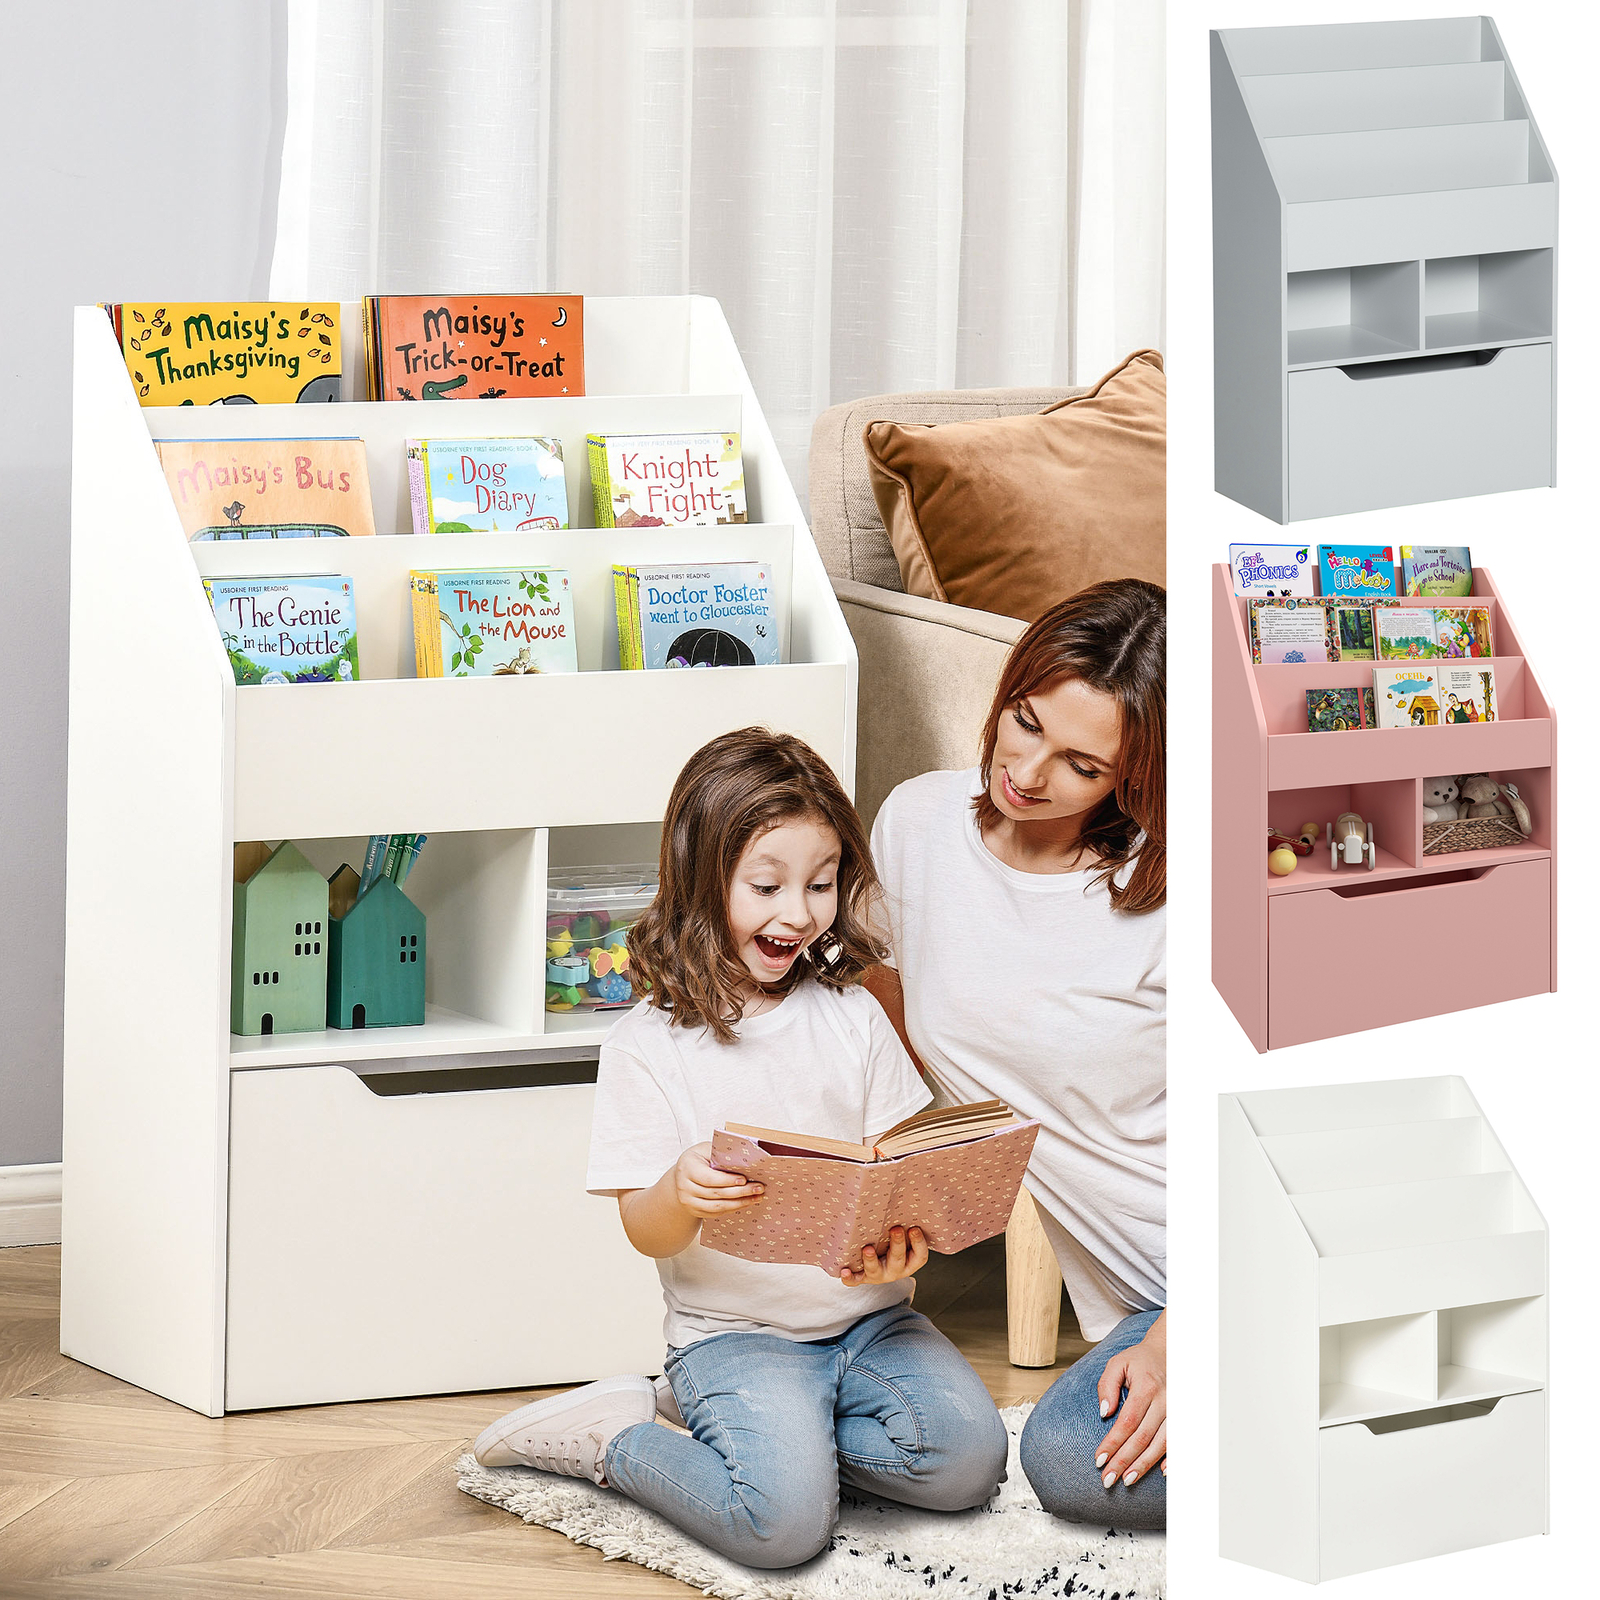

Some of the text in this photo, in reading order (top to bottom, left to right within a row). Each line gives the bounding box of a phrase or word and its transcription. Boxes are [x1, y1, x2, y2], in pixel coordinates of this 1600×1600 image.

[184, 310, 290, 349] Maisy's
[423, 305, 525, 347] Maisy's
[145, 347, 300, 385] Thanksgiving
[395, 341, 565, 378] Trick-or-Treat
[177, 456, 350, 503] Maisy's Bus
[461, 455, 507, 487] Dog
[622, 449, 719, 488] Knight
[476, 485, 536, 517] Diary
[648, 482, 723, 522] Fight
[1238, 564, 1300, 588] PHONICS
[1328, 556, 1361, 569] HELLO
[1412, 563, 1429, 577] Hare
[1429, 559, 1440, 569] and
[1433, 569, 1455, 584] School
[220, 586, 247, 594] USBORNE
[453, 590, 560, 618] The Lion and
[648, 584, 768, 605] Doctor Foster
[229, 596, 341, 629] The Genie
[650, 603, 769, 624] went to Gloucester
[243, 630, 340, 657] in the Bottle
[479, 620, 566, 644] the Mouse
[1395, 672, 1425, 681] ОСЕНЬ
